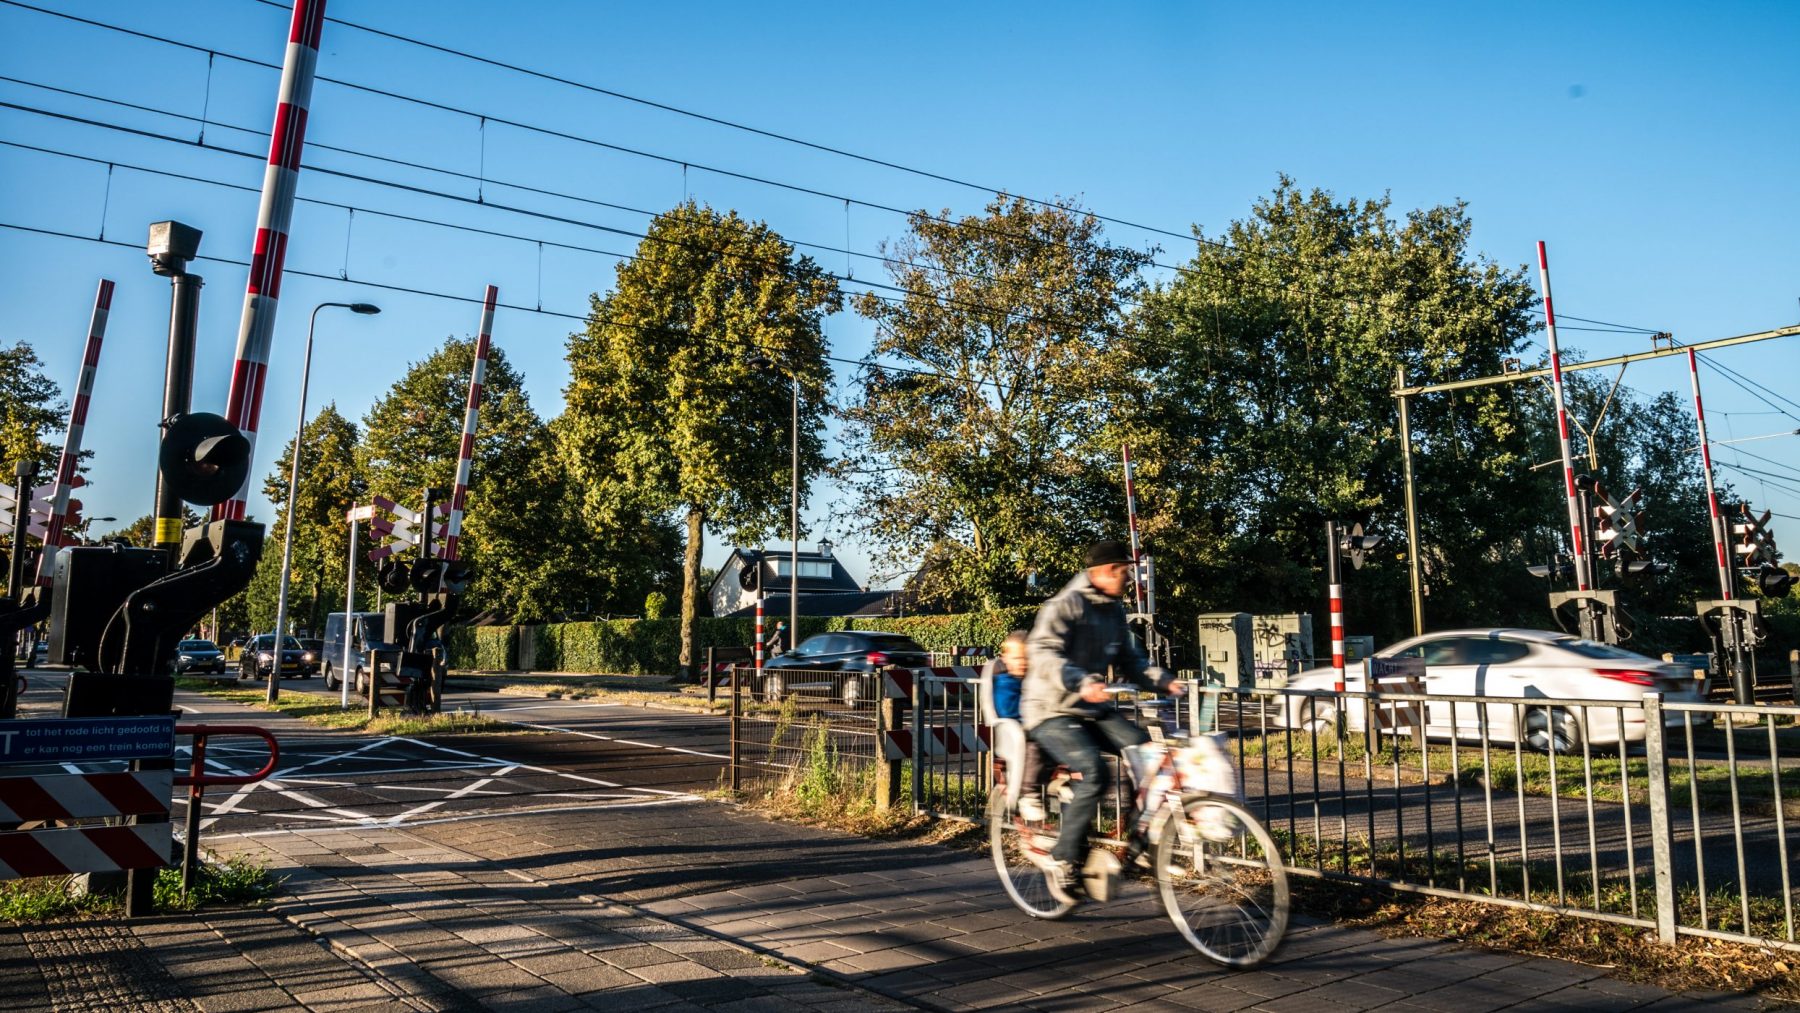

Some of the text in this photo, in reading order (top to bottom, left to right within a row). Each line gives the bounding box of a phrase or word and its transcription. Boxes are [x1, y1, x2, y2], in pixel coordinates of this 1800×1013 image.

[26, 724, 171, 737] tot het rode licht gedoofd is
[39, 745, 59, 753] kan
[62, 745, 83, 754] nog
[86, 744, 105, 752] een
[109, 743, 132, 751] trein
[135, 742, 170, 751] komen
